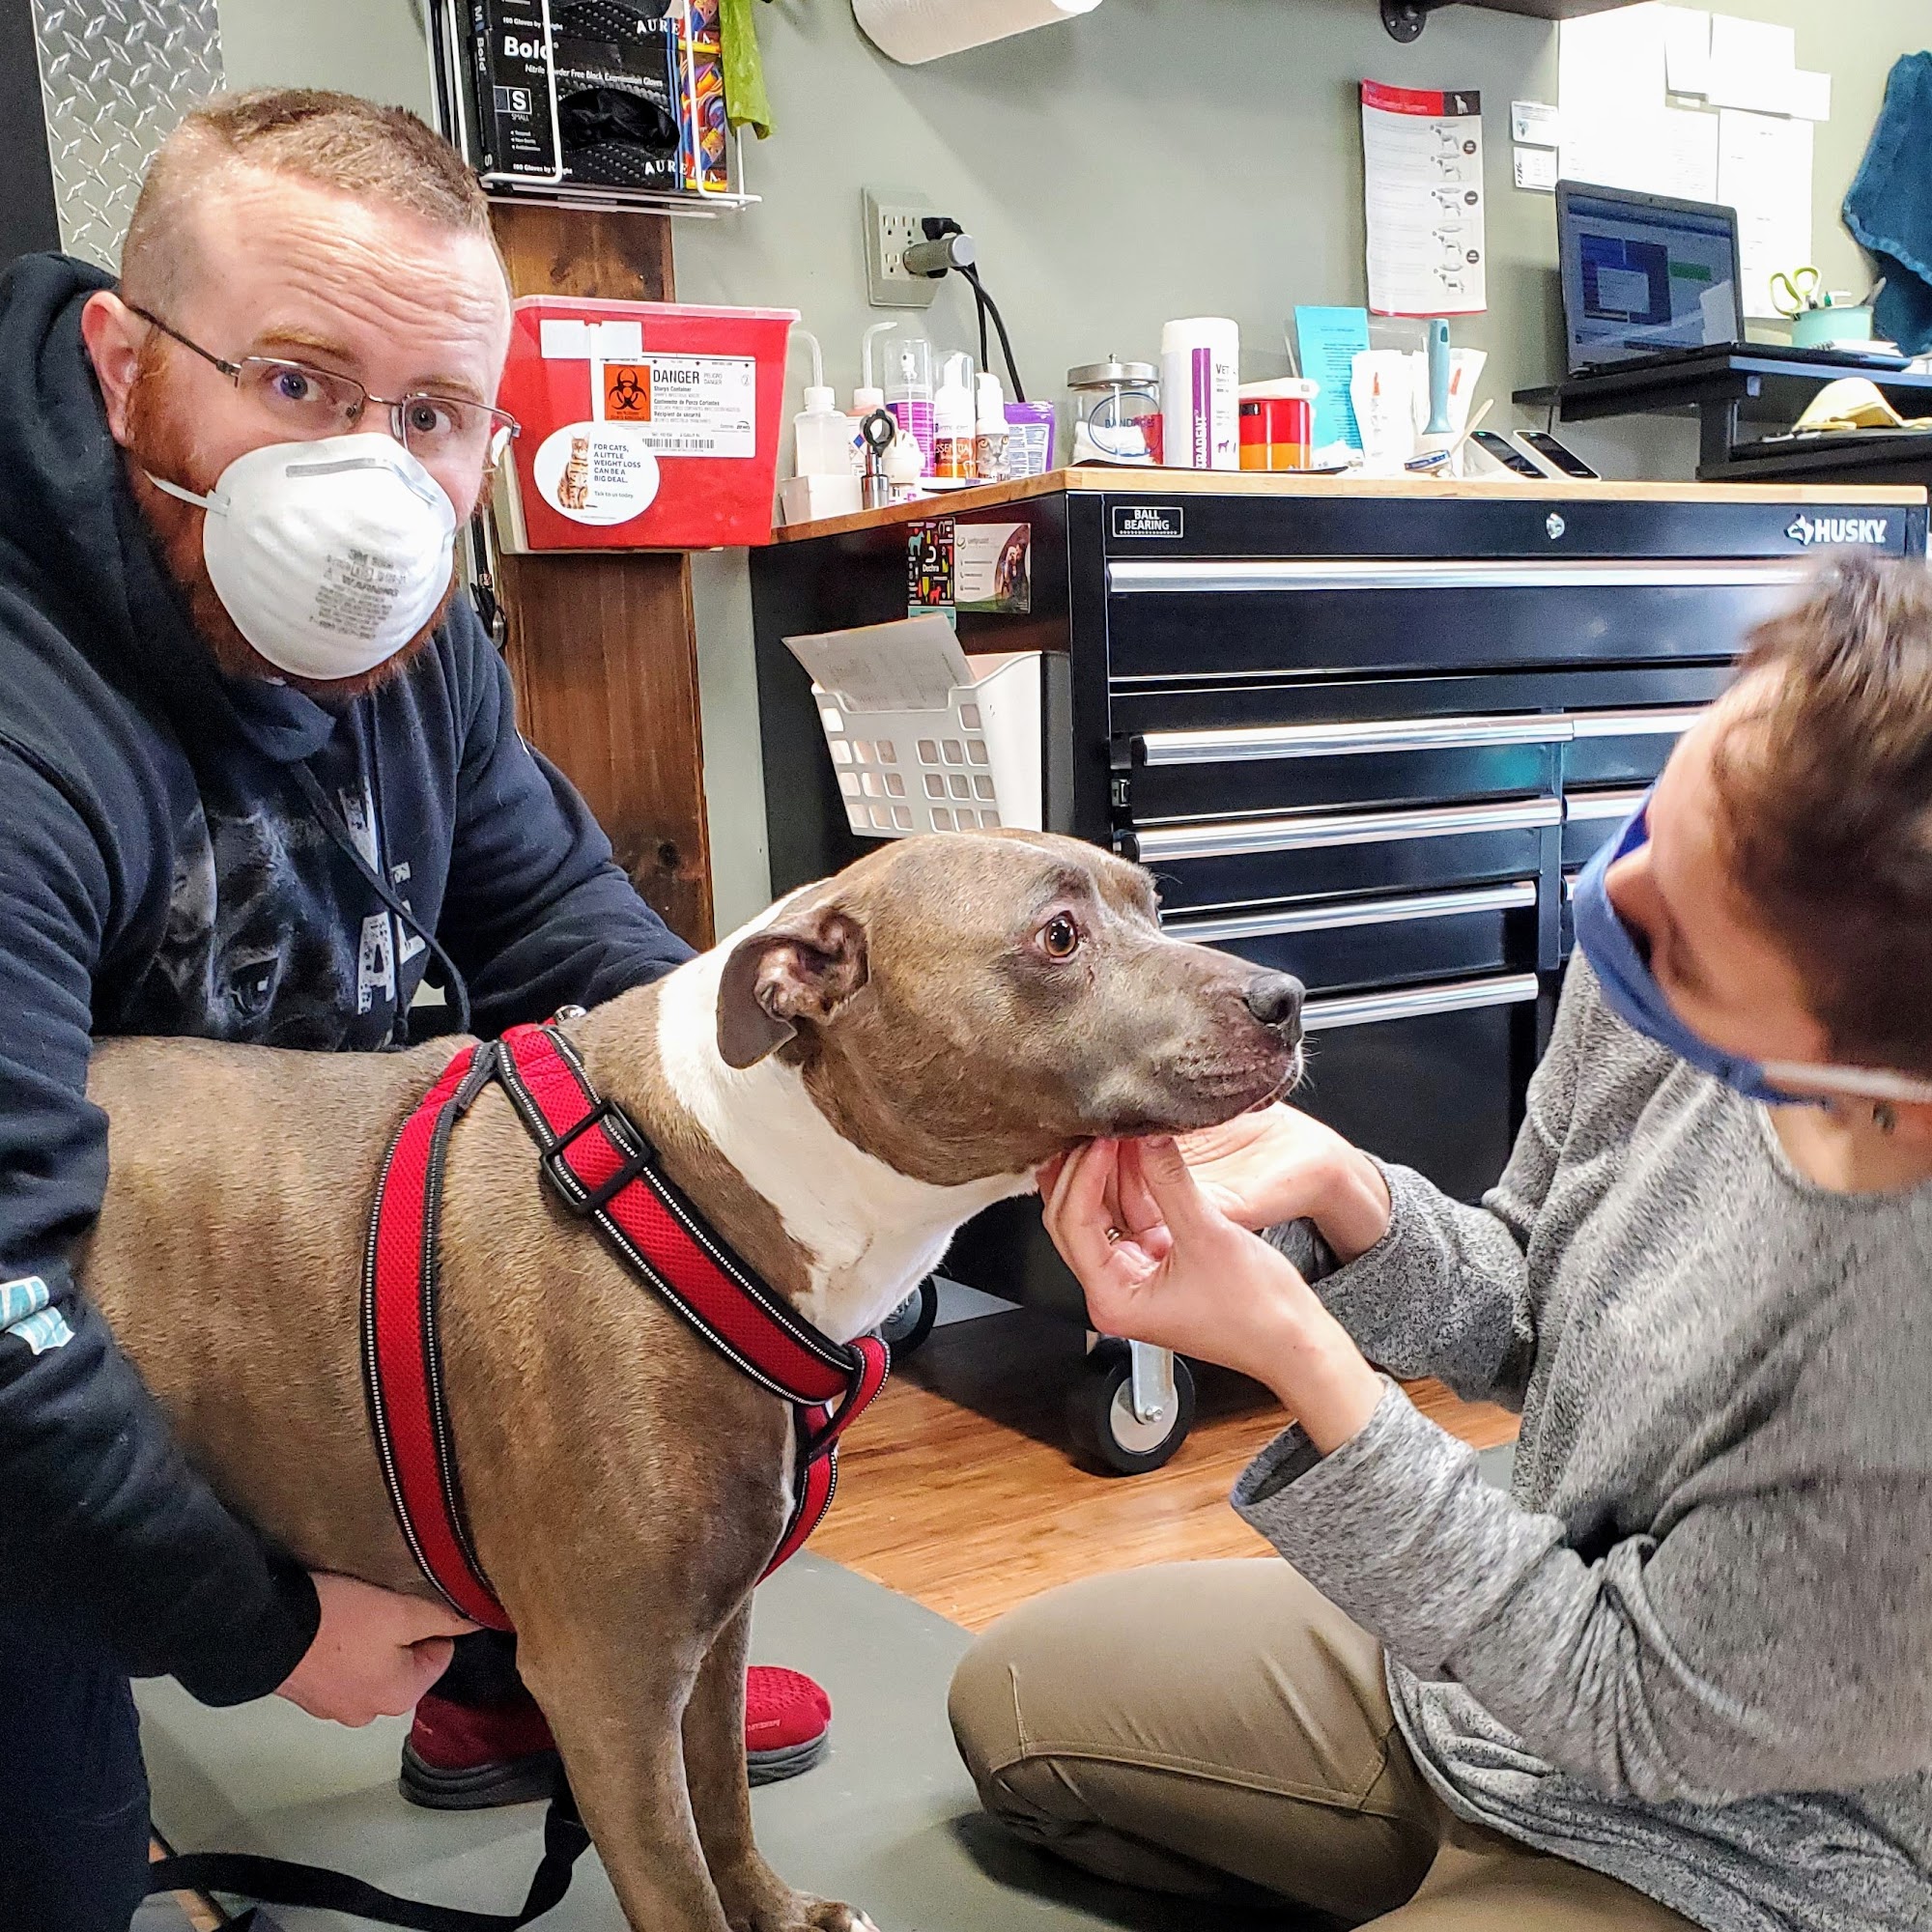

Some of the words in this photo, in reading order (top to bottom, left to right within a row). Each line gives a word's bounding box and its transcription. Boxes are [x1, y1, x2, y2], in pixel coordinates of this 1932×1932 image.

[476, 37, 487, 72] Bold
[525, 64, 546, 74] Nitrile
[571, 68, 584, 78] Free
[512, 91, 527, 111] S
[511, 113, 529, 122] SMALL
[653, 369, 700, 384] DANGER
[609, 444, 629, 453] CATS,
[1134, 509, 1160, 520] BALL
[1124, 520, 1170, 530] BEARING
[1815, 519, 1887, 543] HUSKY
